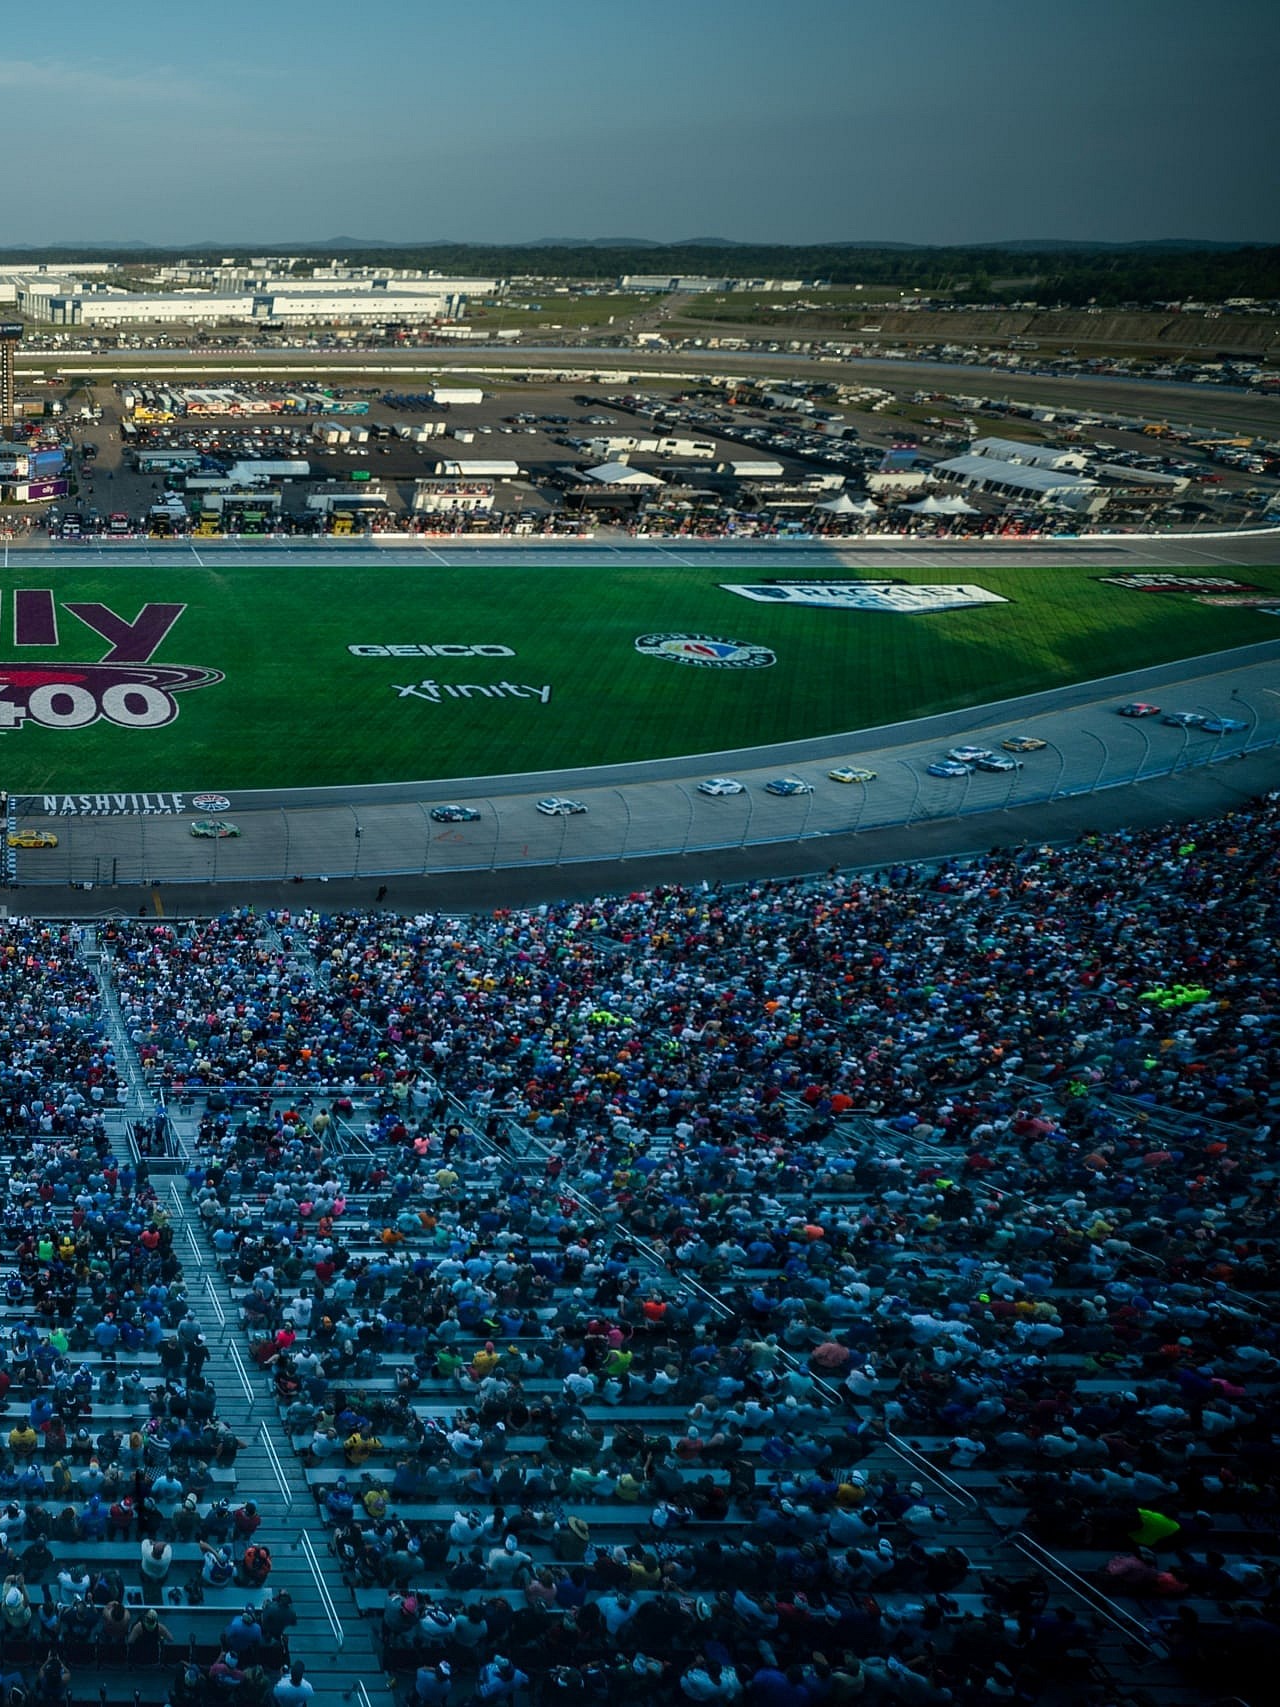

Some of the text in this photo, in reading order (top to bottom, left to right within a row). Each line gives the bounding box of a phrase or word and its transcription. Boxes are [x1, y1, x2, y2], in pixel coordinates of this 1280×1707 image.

[795, 586, 972, 598] RACKLEY
[347, 644, 516, 658] GEICO
[391, 680, 551, 703] xfinity
[43, 793, 186, 810] NASHVILLE
[48, 808, 183, 816] SUPERSPEEDWAY
